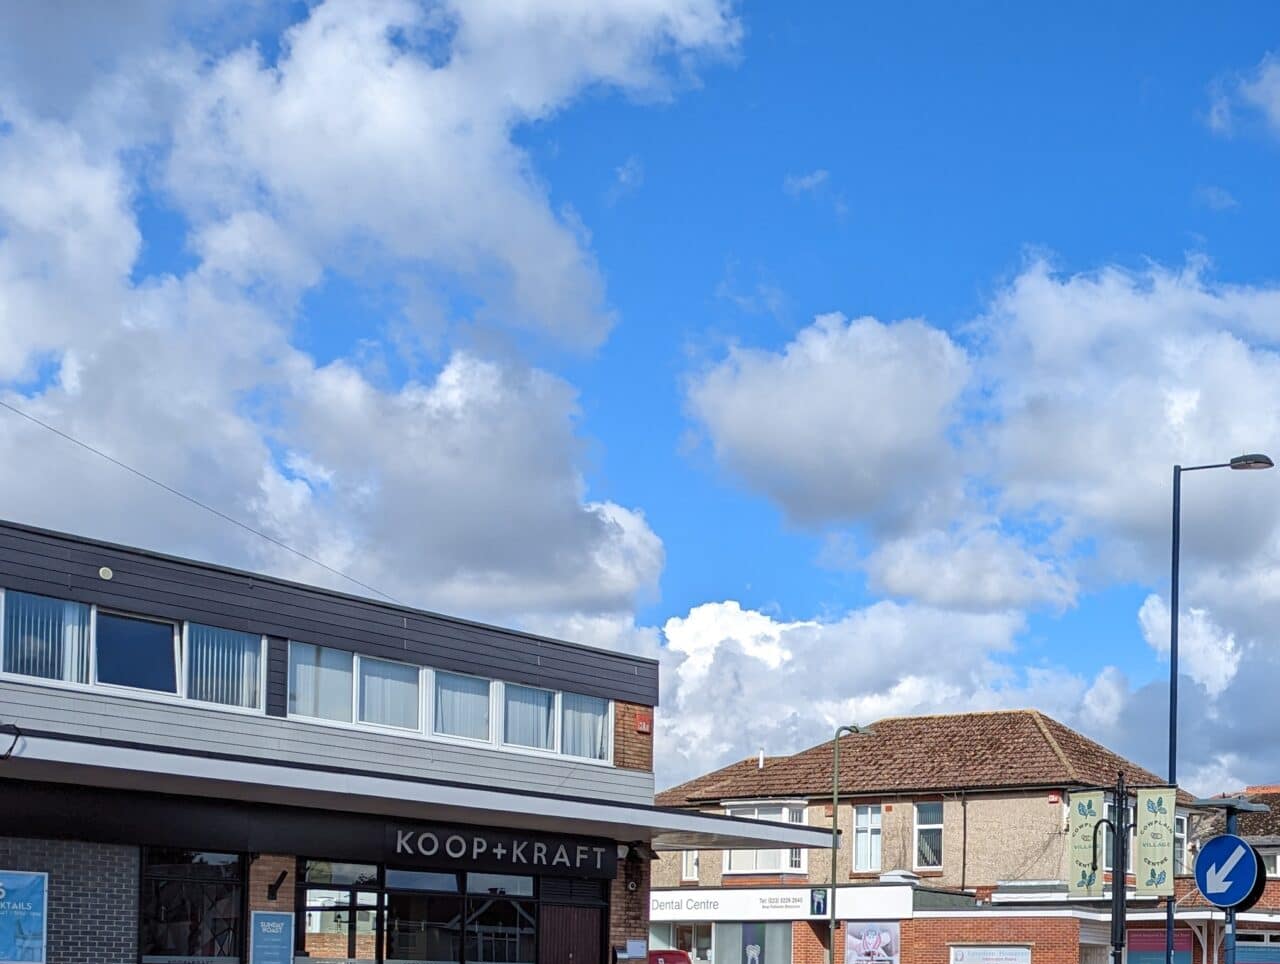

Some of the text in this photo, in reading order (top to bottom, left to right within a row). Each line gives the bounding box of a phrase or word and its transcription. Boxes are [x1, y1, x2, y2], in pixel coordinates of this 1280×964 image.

[396, 829, 606, 869] KOOP+KRAFT
[651, 899, 719, 911] Dental Centre
